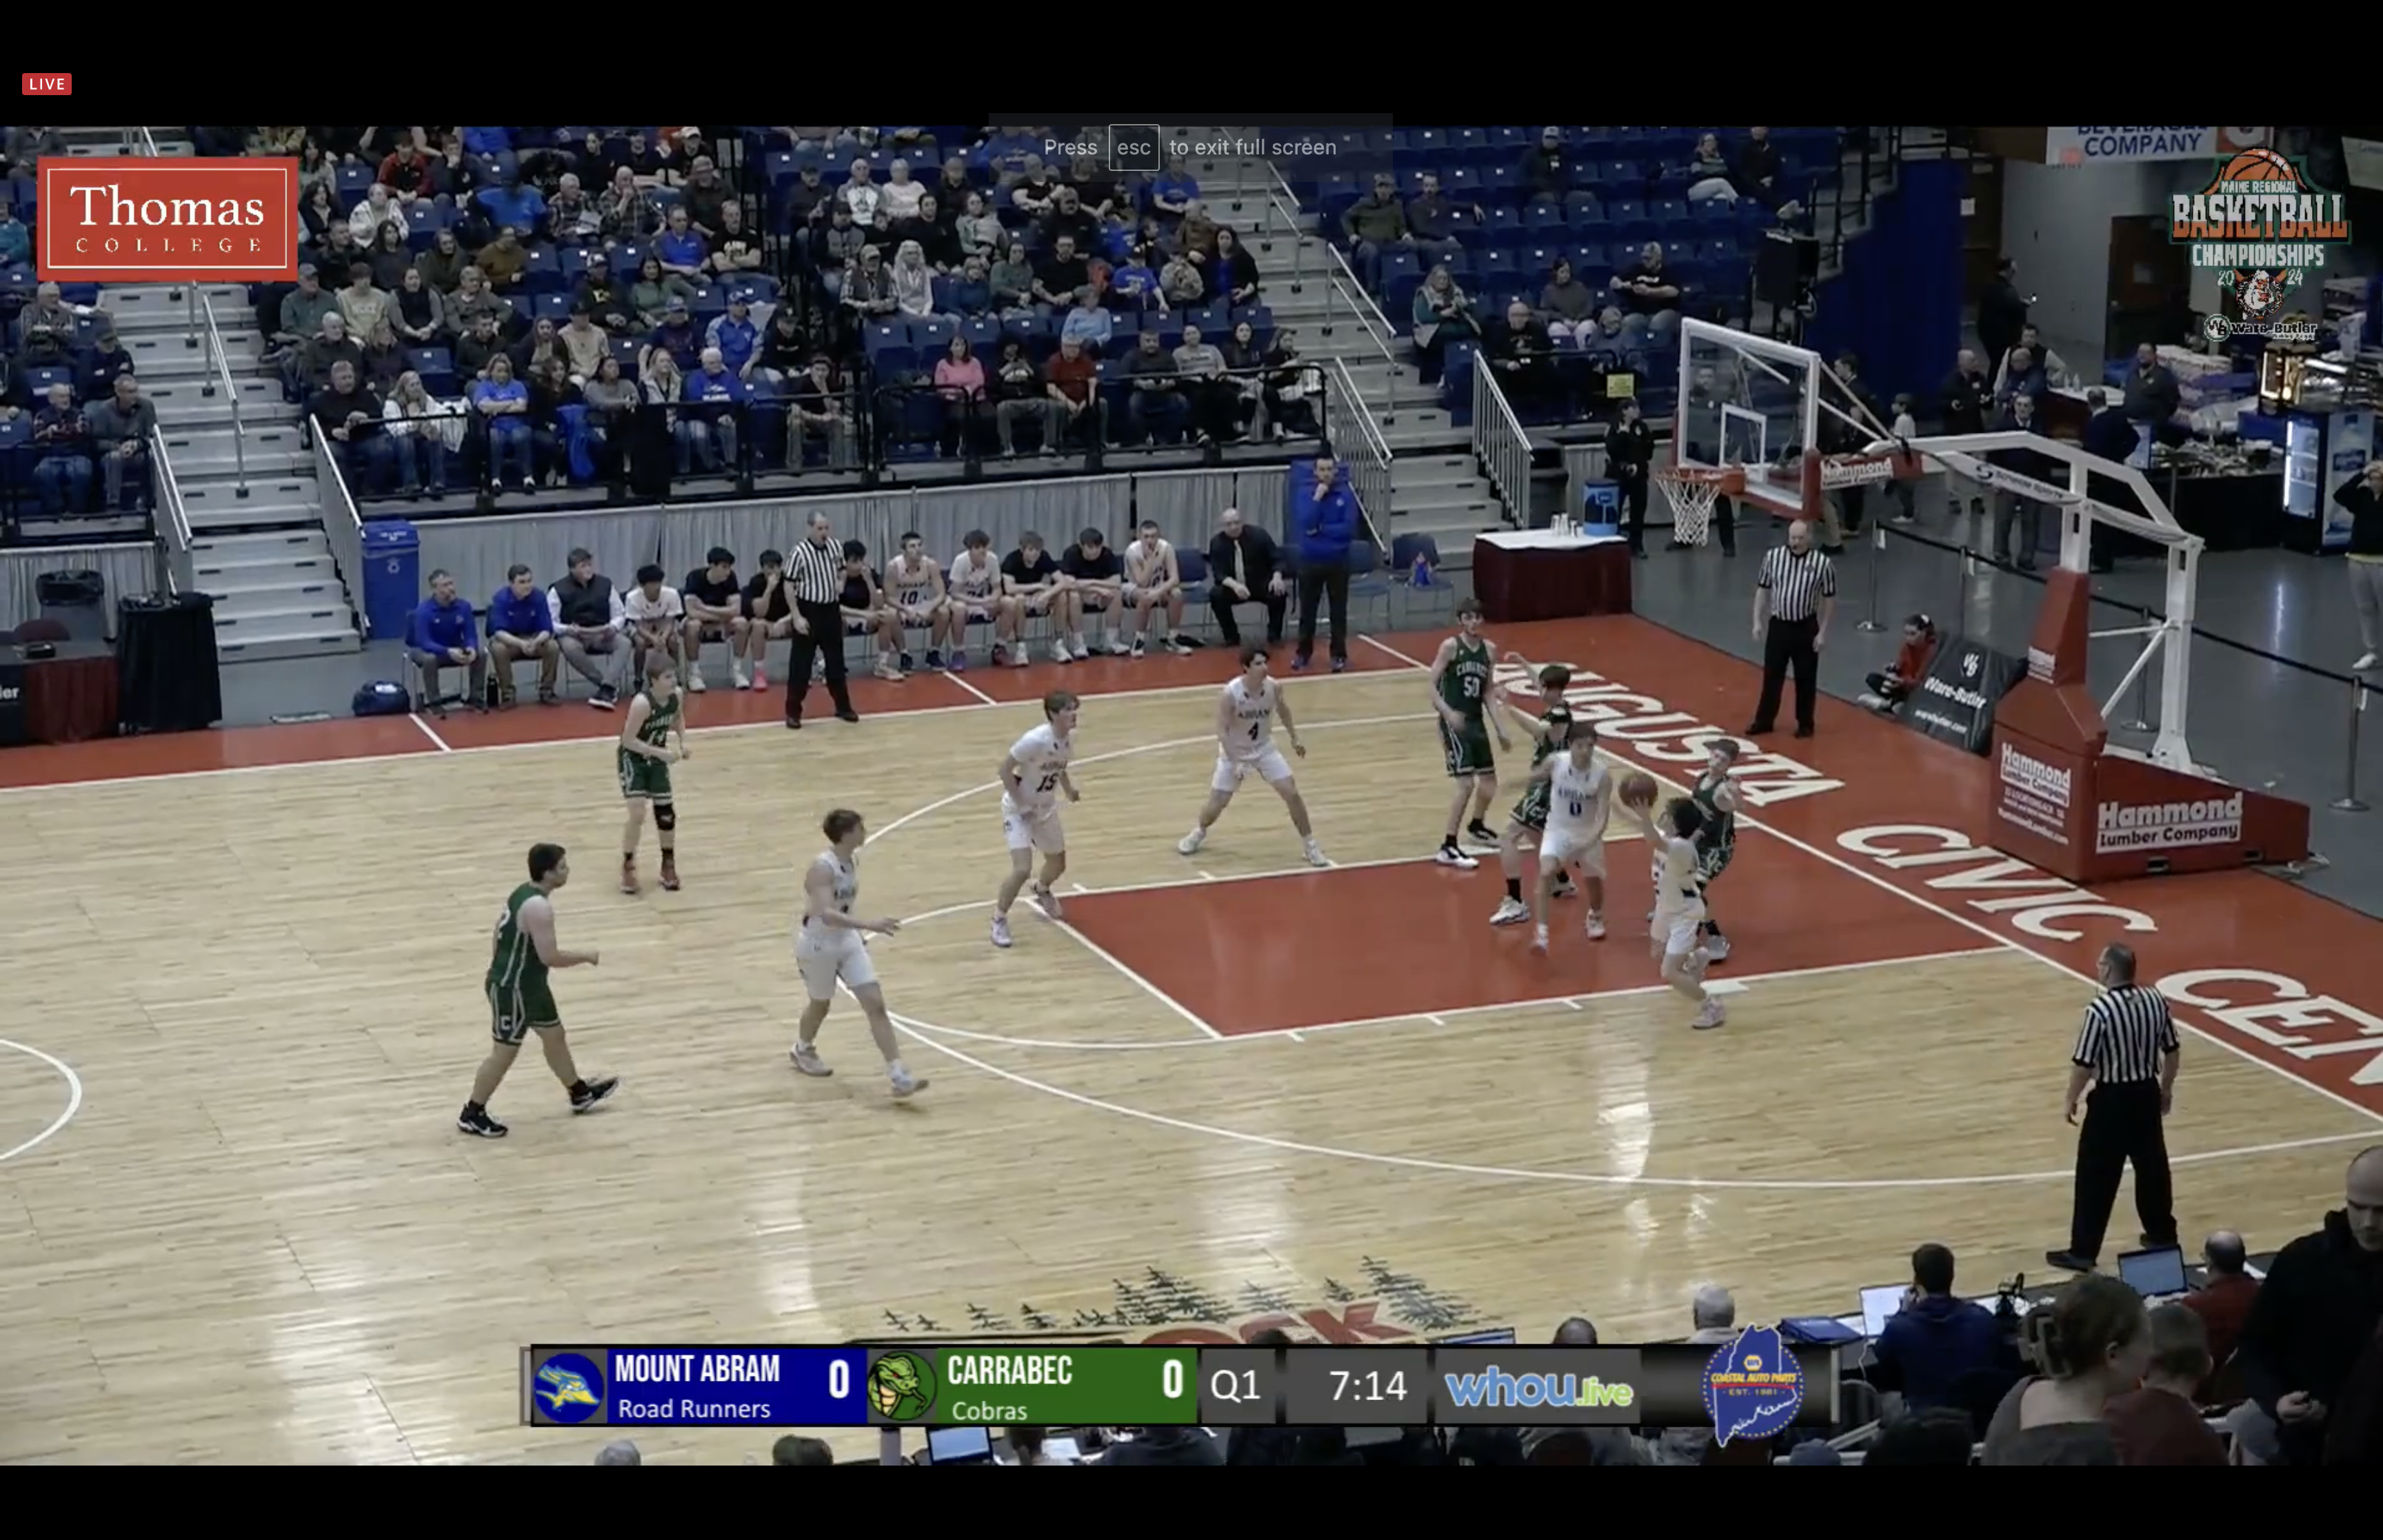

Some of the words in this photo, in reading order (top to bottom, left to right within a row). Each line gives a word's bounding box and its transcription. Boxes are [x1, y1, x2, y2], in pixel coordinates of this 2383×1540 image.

[2084, 132, 2202, 156] COMPANY
[1247, 722, 1258, 740] 4
[2002, 742, 2071, 789] Hammond
[1036, 772, 1059, 793] 15
[2098, 791, 2244, 829] Hammond
[2100, 829, 2158, 847] Lumber
[2163, 824, 2238, 842] Company
[1836, 824, 2159, 941] CIVIC
